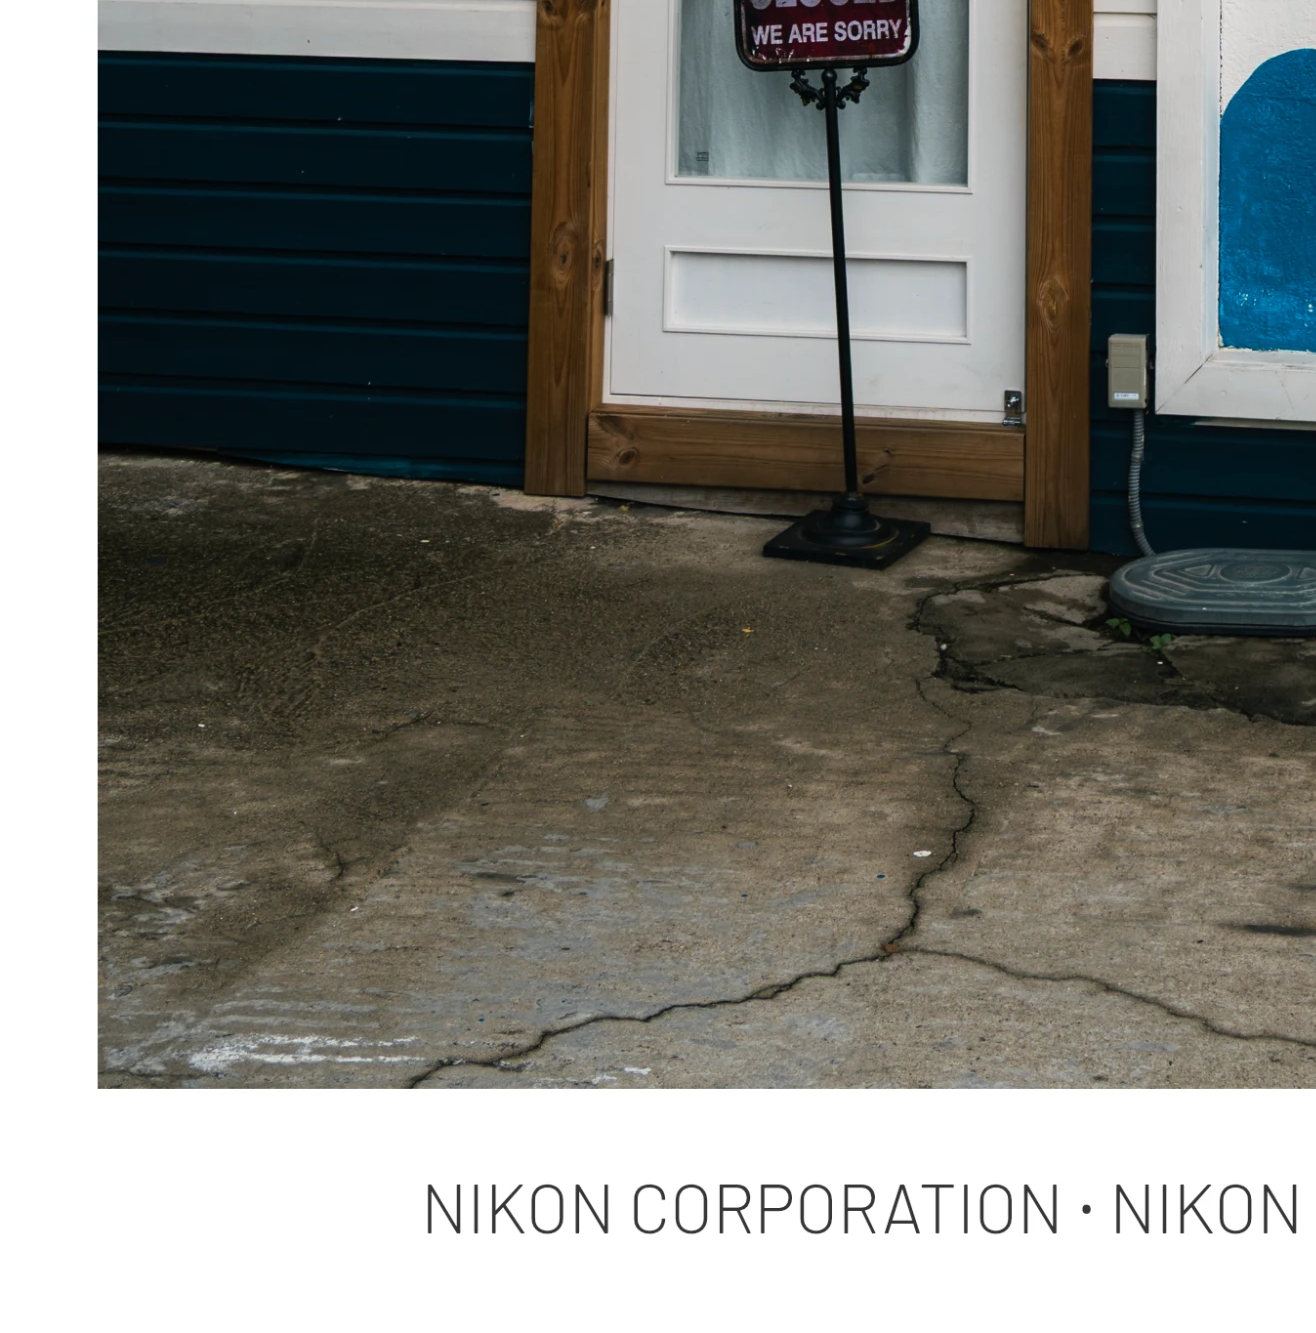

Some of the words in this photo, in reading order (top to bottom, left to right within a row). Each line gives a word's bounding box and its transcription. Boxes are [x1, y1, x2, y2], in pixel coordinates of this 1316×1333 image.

[752, 24, 783, 46] WE
[788, 22, 829, 44] ARE
[834, 19, 902, 42] SORRY
